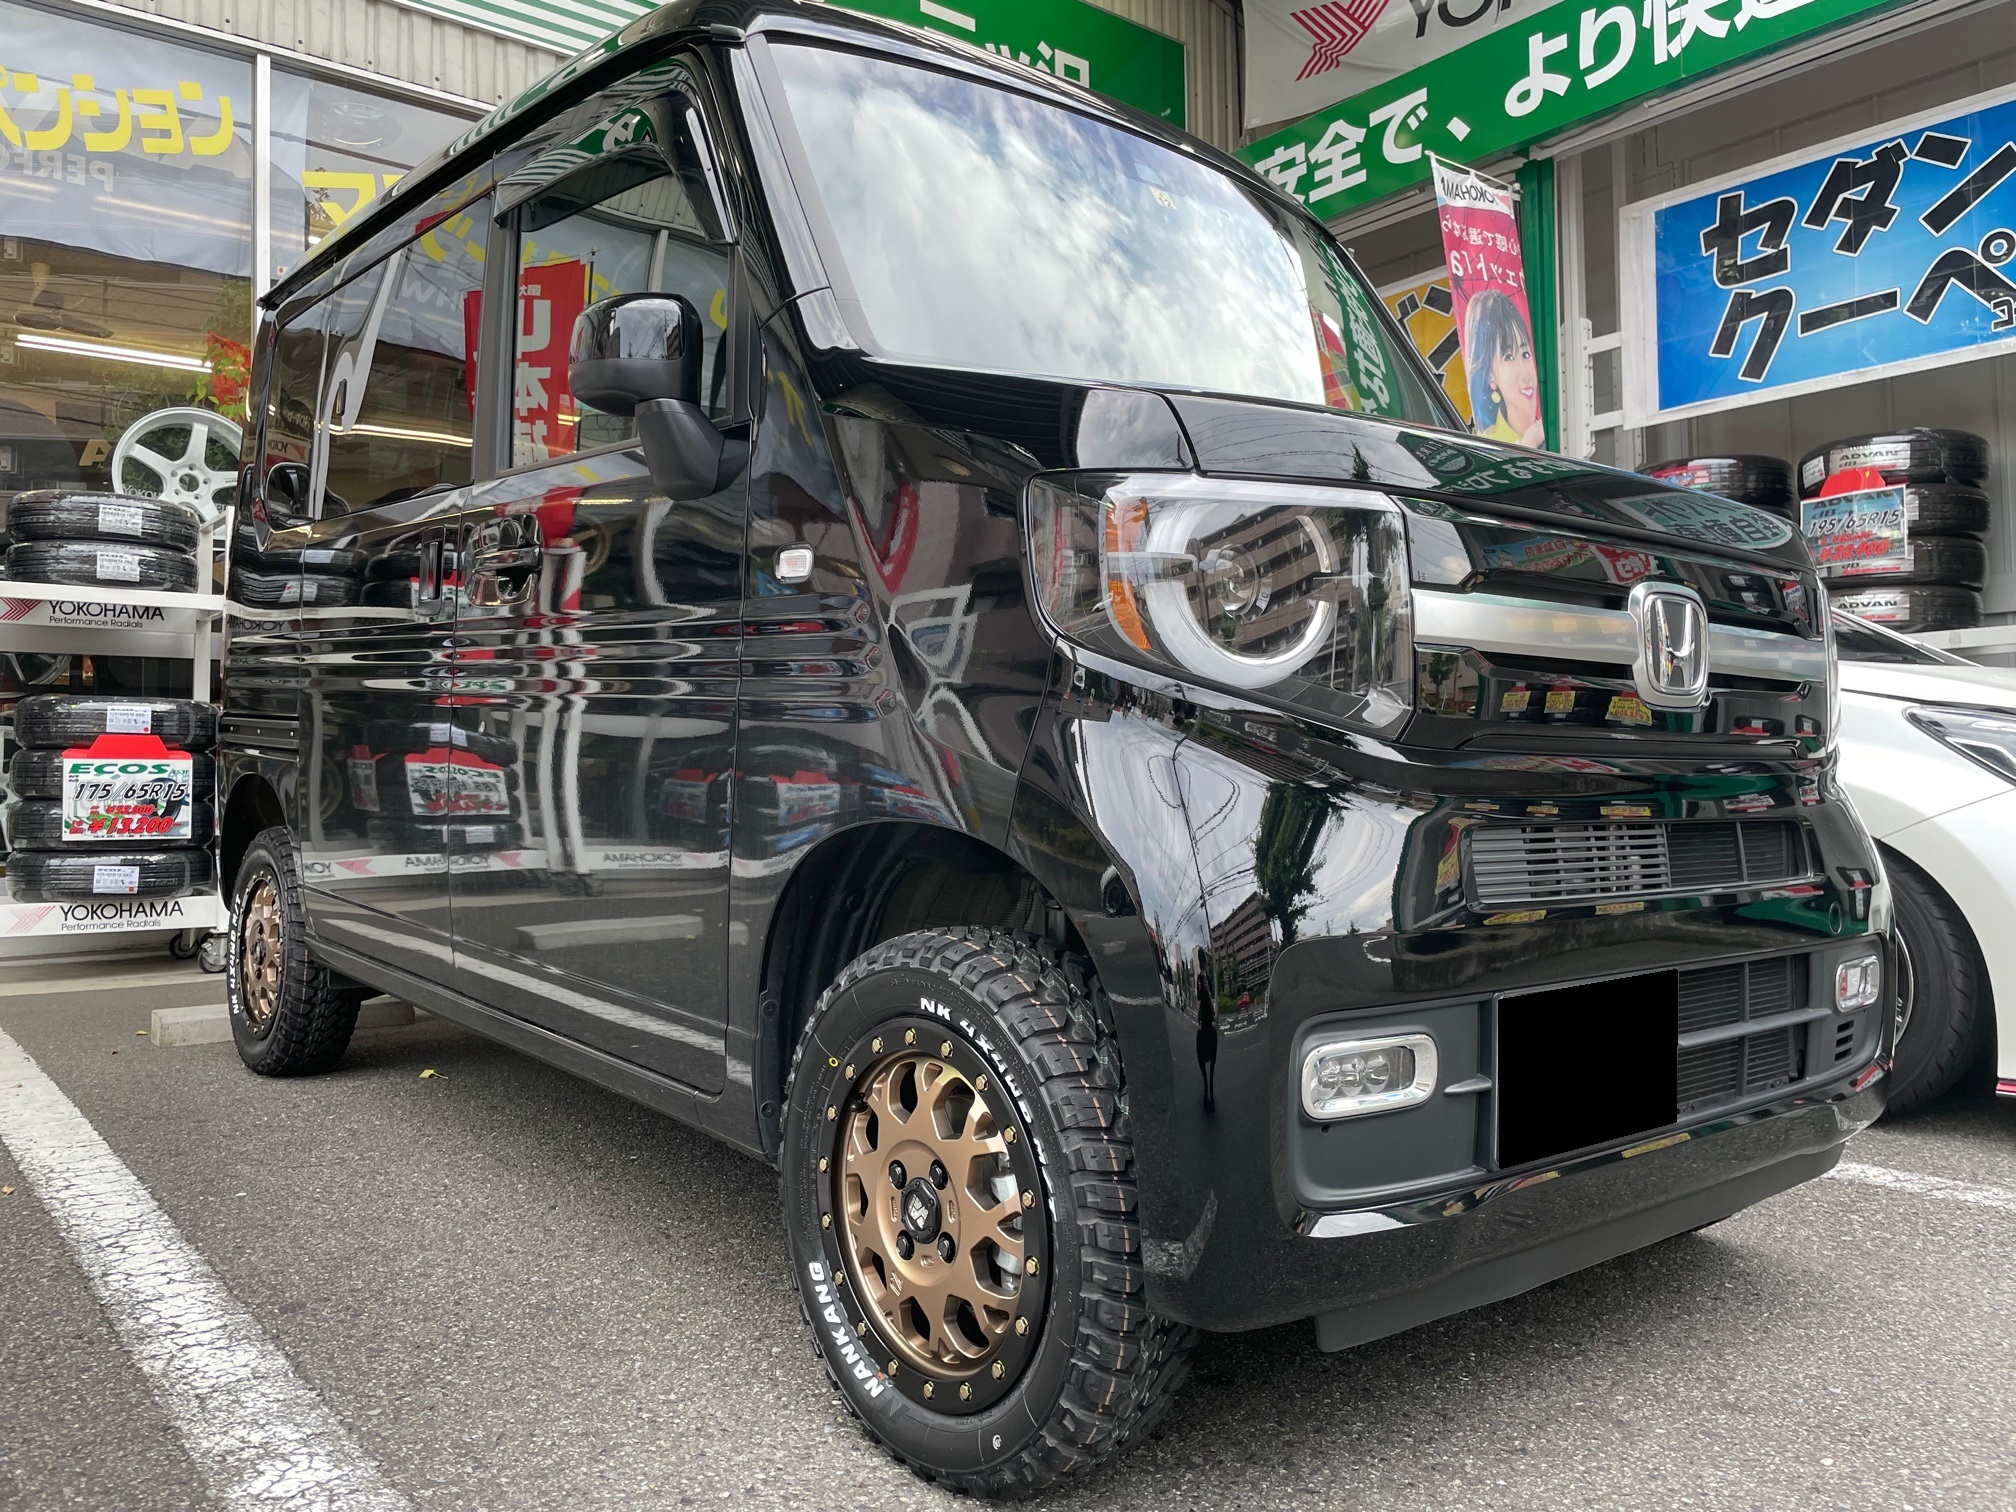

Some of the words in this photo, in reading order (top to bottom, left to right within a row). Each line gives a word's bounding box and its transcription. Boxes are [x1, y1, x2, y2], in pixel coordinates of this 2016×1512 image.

[1699, 131, 2016, 289] セダン
[1708, 228, 2016, 383] クーペ
[1840, 450, 1899, 462] ADVAN
[1812, 490, 1895, 510] ADVAN
[1808, 509, 1902, 537] 195/65R15
[48, 600, 165, 621] YOKOHAMA
[1837, 599, 1899, 609] ADVAN
[49, 615, 109, 627] Performance
[110, 618, 144, 629] Radials
[68, 763, 171, 774] ECOS
[74, 782, 189, 802] 175/65R15
[59, 900, 184, 922] YOKOHAMA
[61, 921, 125, 931] Performance
[127, 918, 162, 928] Radials
[920, 997, 953, 1022] NK
[808, 1261, 885, 1398] NANKANG
